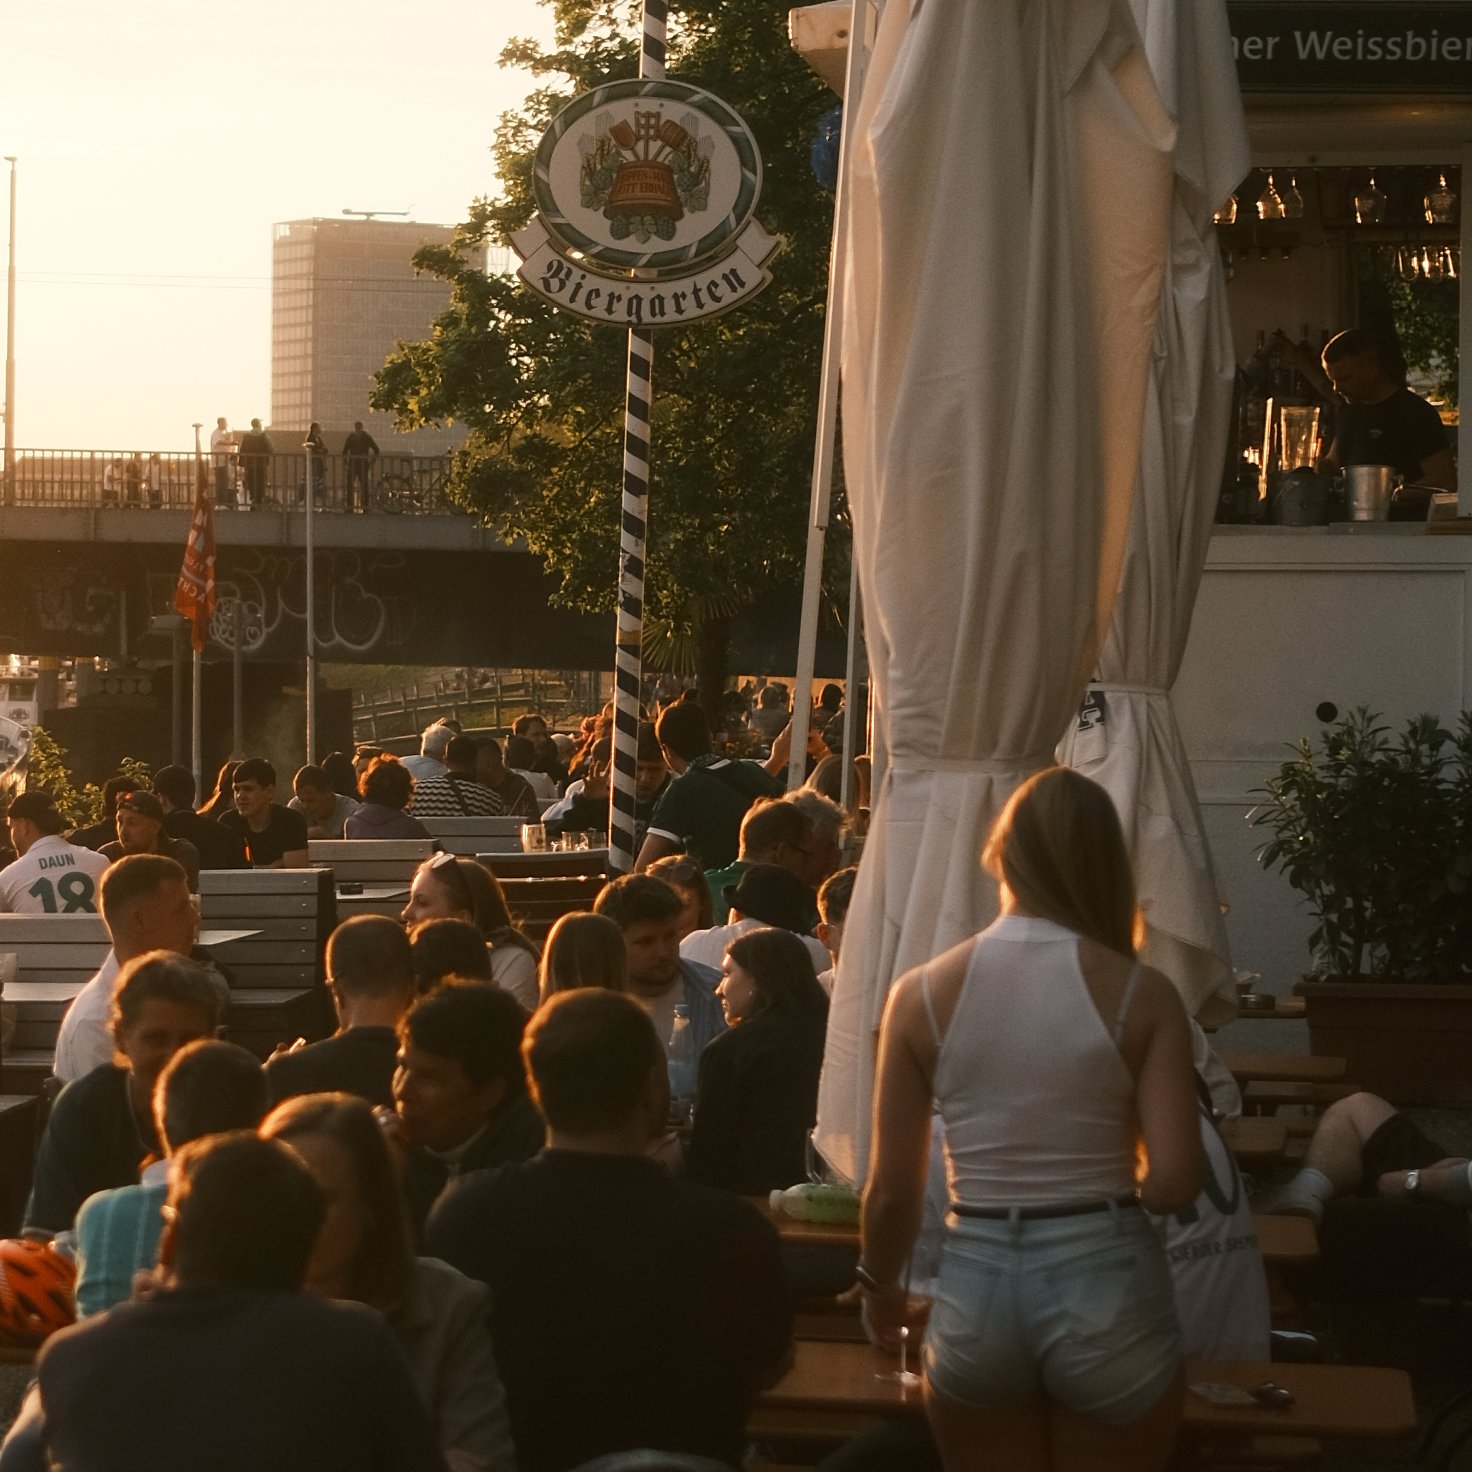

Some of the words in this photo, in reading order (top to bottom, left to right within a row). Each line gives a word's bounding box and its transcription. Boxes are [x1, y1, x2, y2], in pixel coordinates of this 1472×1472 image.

[1293, 29, 1472, 61] Weissbier
[538, 259, 746, 325] Biergarten
[38, 853, 75, 870] DAUN
[29, 872, 97, 913] 18
